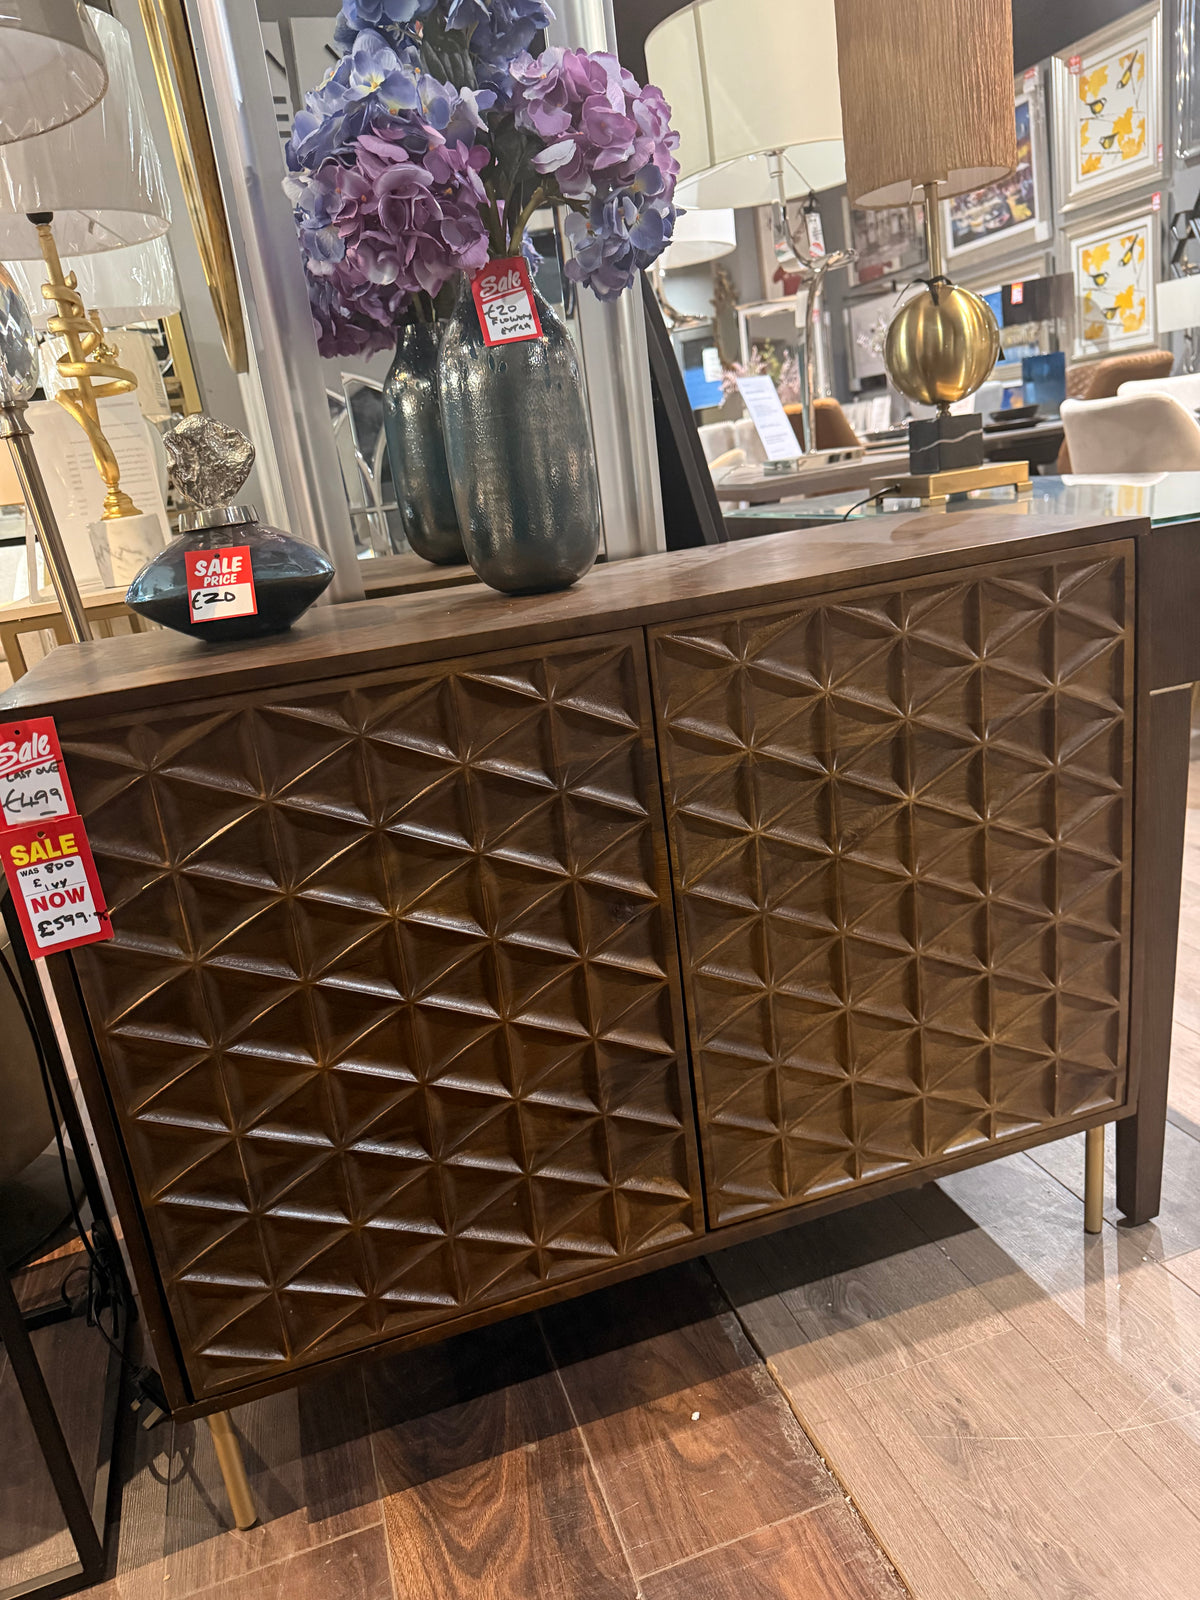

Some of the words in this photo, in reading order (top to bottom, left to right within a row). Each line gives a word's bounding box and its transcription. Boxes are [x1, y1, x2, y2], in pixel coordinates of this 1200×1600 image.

[480, 269, 523, 299] Sale
[484, 304, 517, 320] £20
[194, 556, 243, 576] SALE
[203, 573, 237, 587] PRICE
[191, 591, 236, 610] £20
[0, 732, 51, 771] Sale
[10, 833, 79, 866] SALE
[20, 867, 40, 878] WAS
[33, 878, 42, 888] £
[30, 886, 85, 914] NOW
